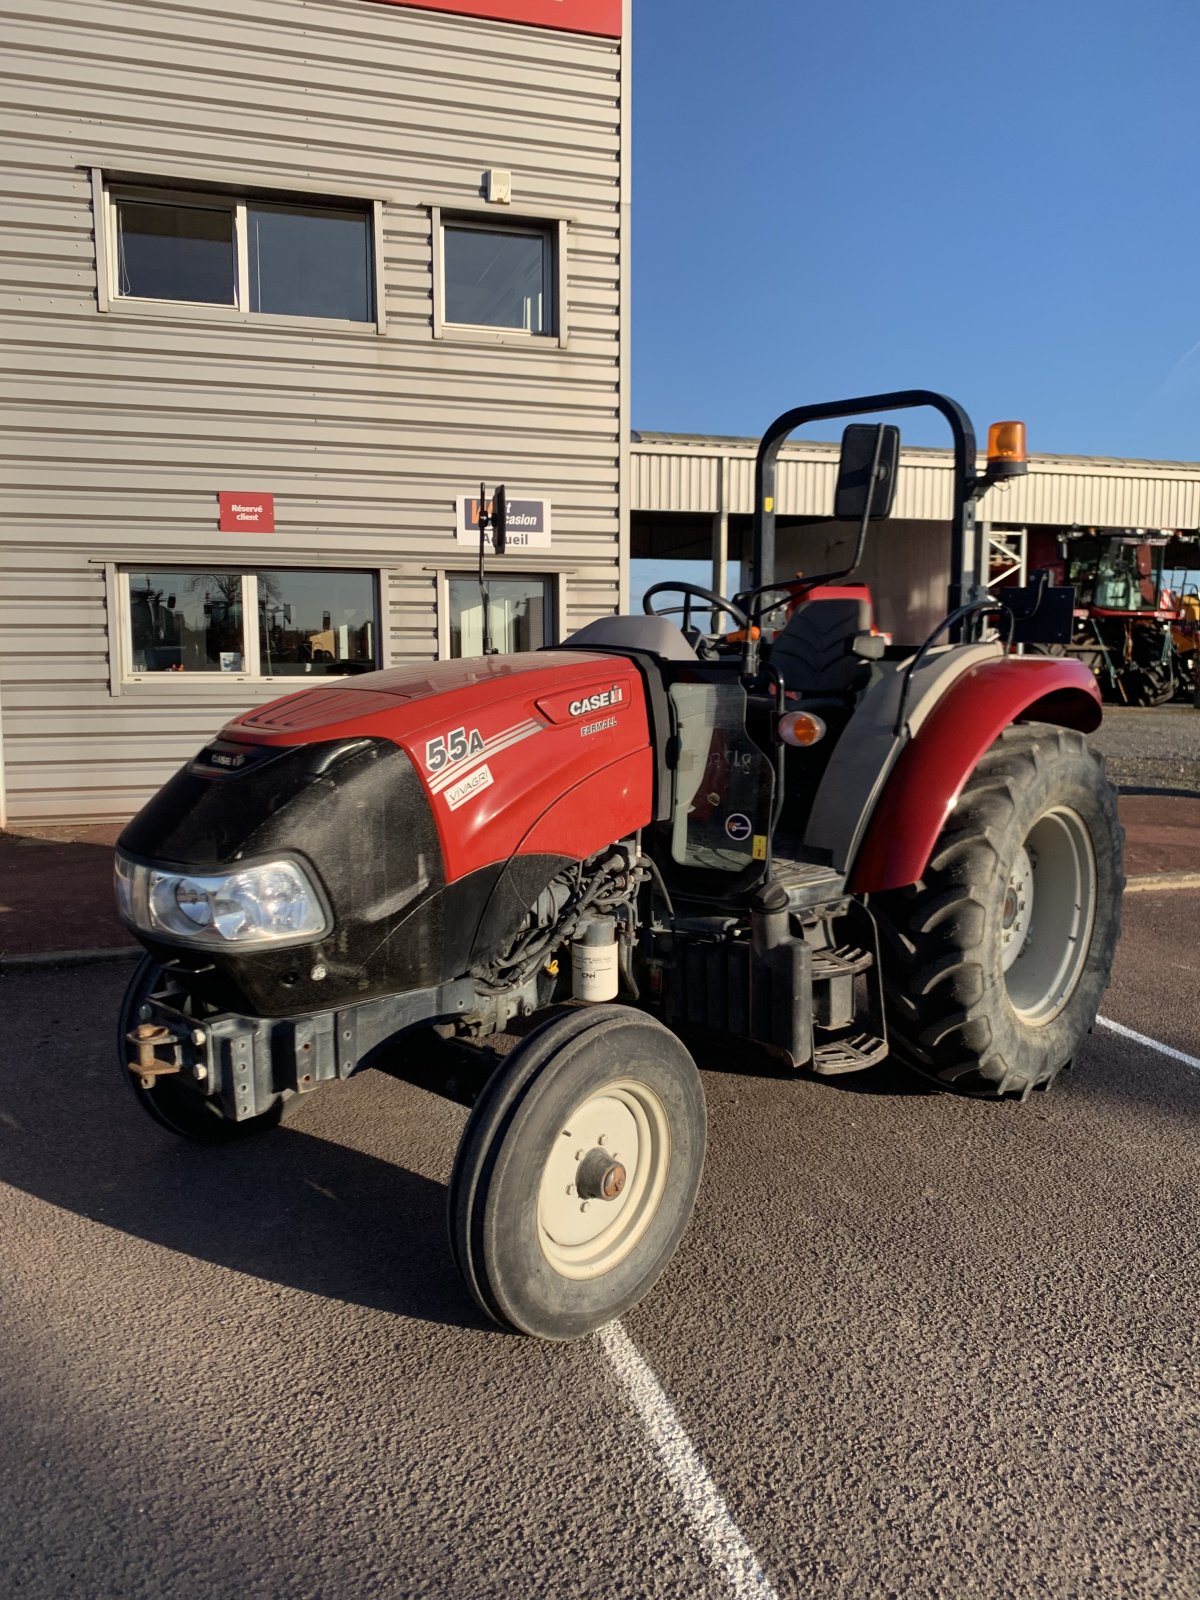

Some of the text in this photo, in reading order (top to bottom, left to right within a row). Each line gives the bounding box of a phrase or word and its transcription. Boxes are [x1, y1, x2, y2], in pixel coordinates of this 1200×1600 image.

[231, 504, 263, 513] Réservé
[236, 513, 259, 521] client
[482, 532, 529, 545] Aueil
[580, 717, 618, 737] FARMALL
[425, 727, 485, 772] 55A
[448, 769, 490, 802] VIVAGRI
